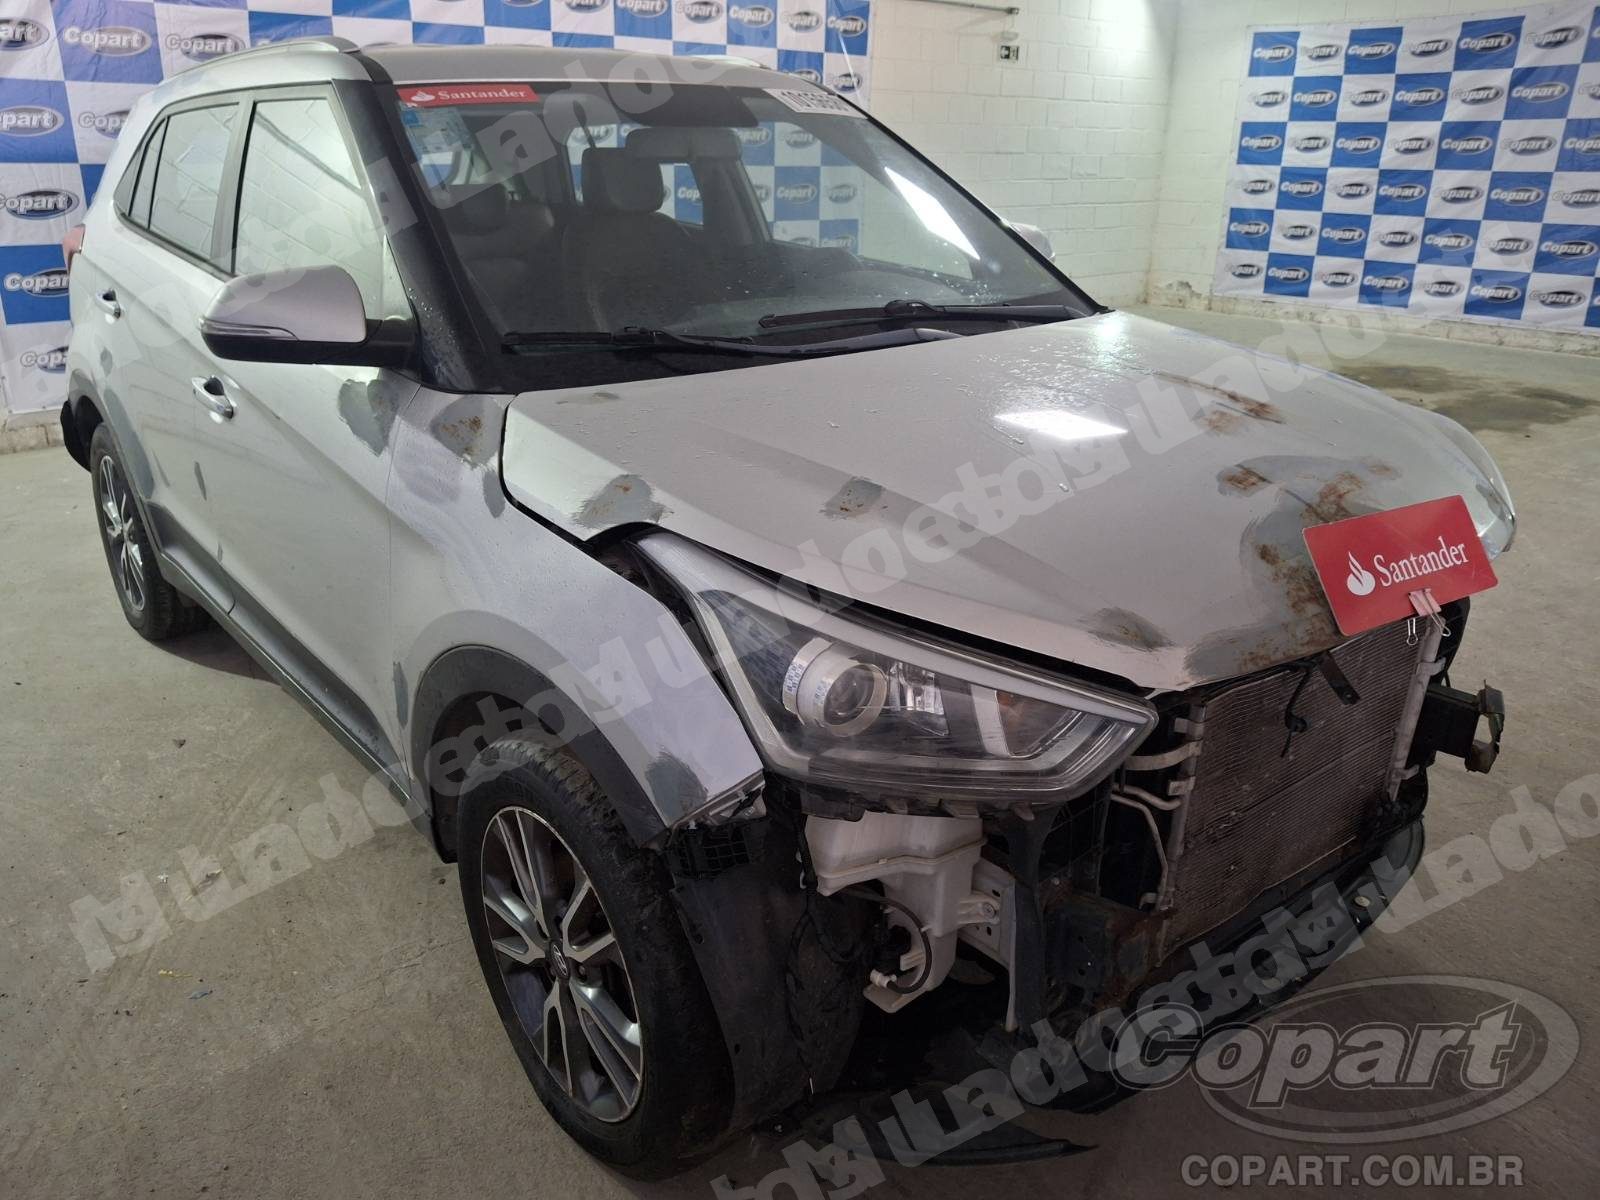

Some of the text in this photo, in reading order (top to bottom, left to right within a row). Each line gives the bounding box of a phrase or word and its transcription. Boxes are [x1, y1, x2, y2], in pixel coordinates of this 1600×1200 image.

[675, 1, 719, 18] Copart
[729, 5, 769, 24] Copart
[827, 17, 863, 33] Copart
[64, 26, 141, 49] Copart
[166, 34, 236, 55] Copart
[1459, 34, 1510, 51] Copart
[1527, 28, 1577, 46] Copart
[1253, 47, 1290, 61] Copart
[1302, 46, 1338, 59] opart
[1348, 43, 1391, 58] Copart
[437, 88, 527, 100] Santander
[1253, 92, 1287, 105] opart
[1293, 90, 1334, 105] Copart
[1347, 91, 1386, 105] opart
[1396, 88, 1440, 105] Copart
[1452, 87, 1498, 103] Copart
[1512, 84, 1563, 101] Copart
[1241, 136, 1278, 150] Copart
[1290, 137, 1326, 150] opart
[1336, 137, 1376, 152] Copart
[1441, 137, 1487, 153] Copart
[1281, 181, 1319, 196] Copart
[1333, 183, 1369, 197] opart
[1379, 185, 1420, 200] Copart
[1491, 188, 1536, 205] Copart
[1230, 222, 1265, 236] Copart
[1280, 225, 1311, 239] opart
[1321, 227, 1361, 242] Copart
[1425, 234, 1467, 250] Copart
[1541, 241, 1590, 257] Copart
[1268, 267, 1305, 282] Copart
[1363, 275, 1404, 290] Copart
[1471, 285, 1516, 301] Copart
[1529, 290, 1579, 307] Copart
[1373, 536, 1468, 587] Santander
